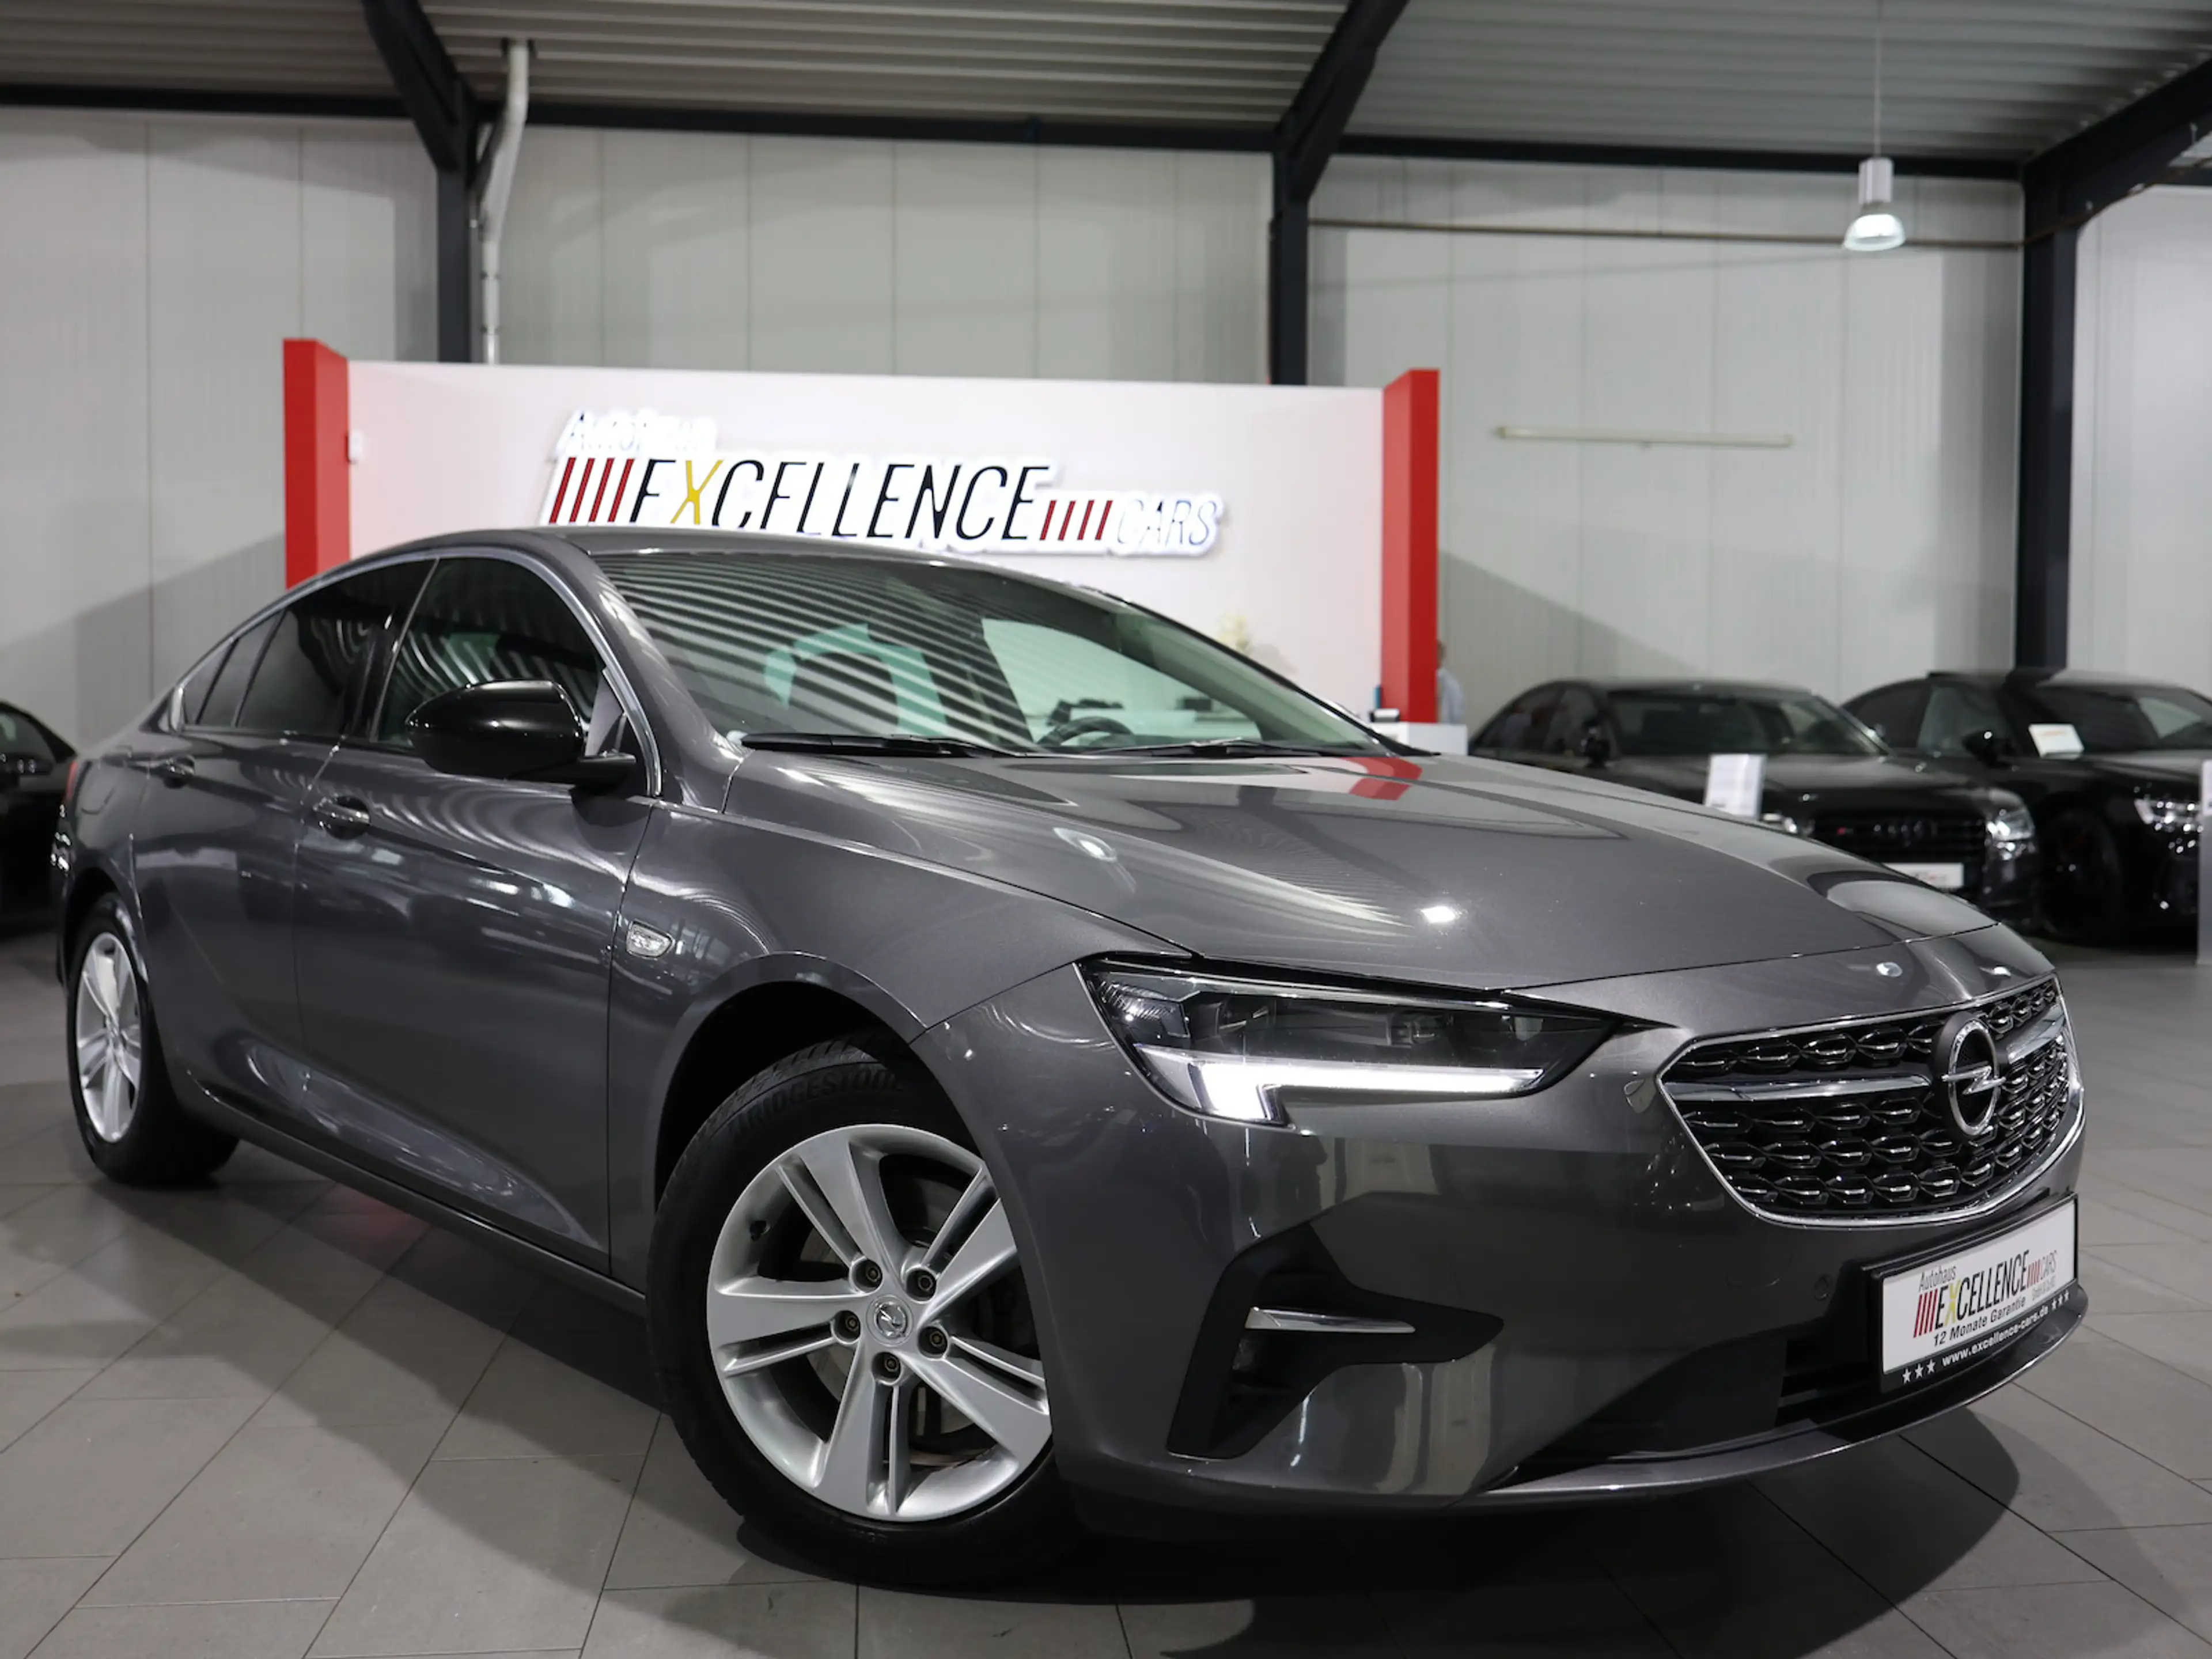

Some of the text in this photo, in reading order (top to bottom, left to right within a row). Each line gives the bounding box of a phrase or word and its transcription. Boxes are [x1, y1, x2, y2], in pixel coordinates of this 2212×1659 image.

[629, 459, 1216, 545] EXCELLENCE CARS
[1919, 1266, 1956, 1293] Autohaus
[1936, 1249, 2029, 1329] EXCELLENCE
[2040, 1249, 2057, 1280] CARS
[1934, 1296, 2025, 1346] 12 Monate Garantie
[1942, 1305, 2048, 1367] www.excellence-cars.de
